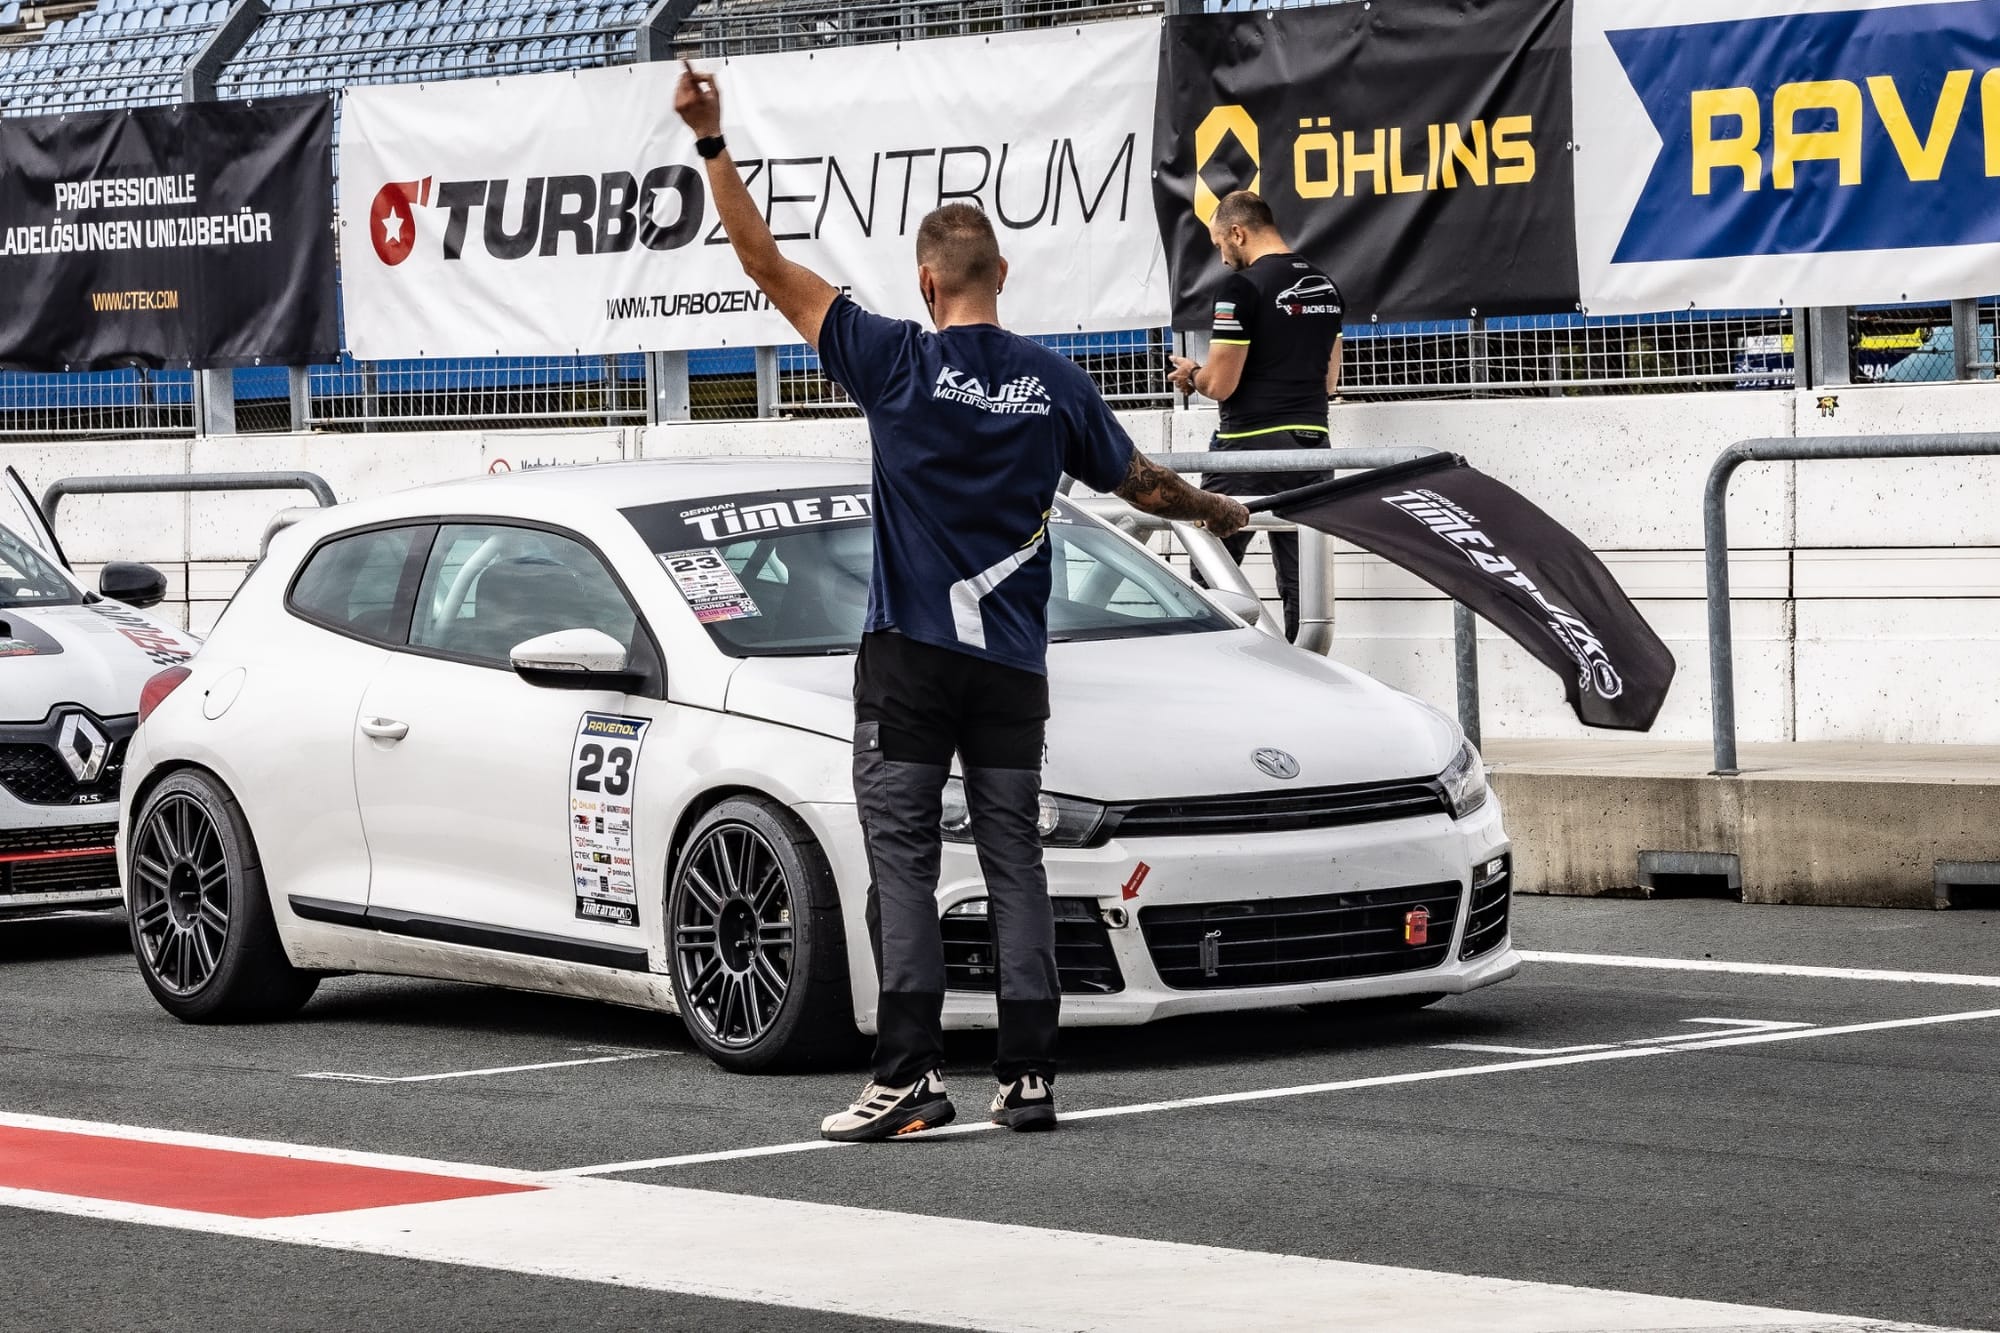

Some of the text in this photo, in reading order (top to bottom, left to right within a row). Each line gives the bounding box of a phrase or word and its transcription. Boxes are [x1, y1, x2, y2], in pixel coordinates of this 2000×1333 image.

[1691, 66, 2000, 196] RAV
[1294, 115, 1536, 199] ÖHLINS
[54, 174, 196, 211] PROFESSIONELLE
[92, 290, 179, 311] WWW.CTEK.COM
[933, 385, 1051, 416] MOTORSPORT.COM
[680, 502, 735, 519] GERMAN
[671, 556, 722, 573] 23
[588, 721, 636, 736] RAVENOL
[576, 743, 633, 796] 23
